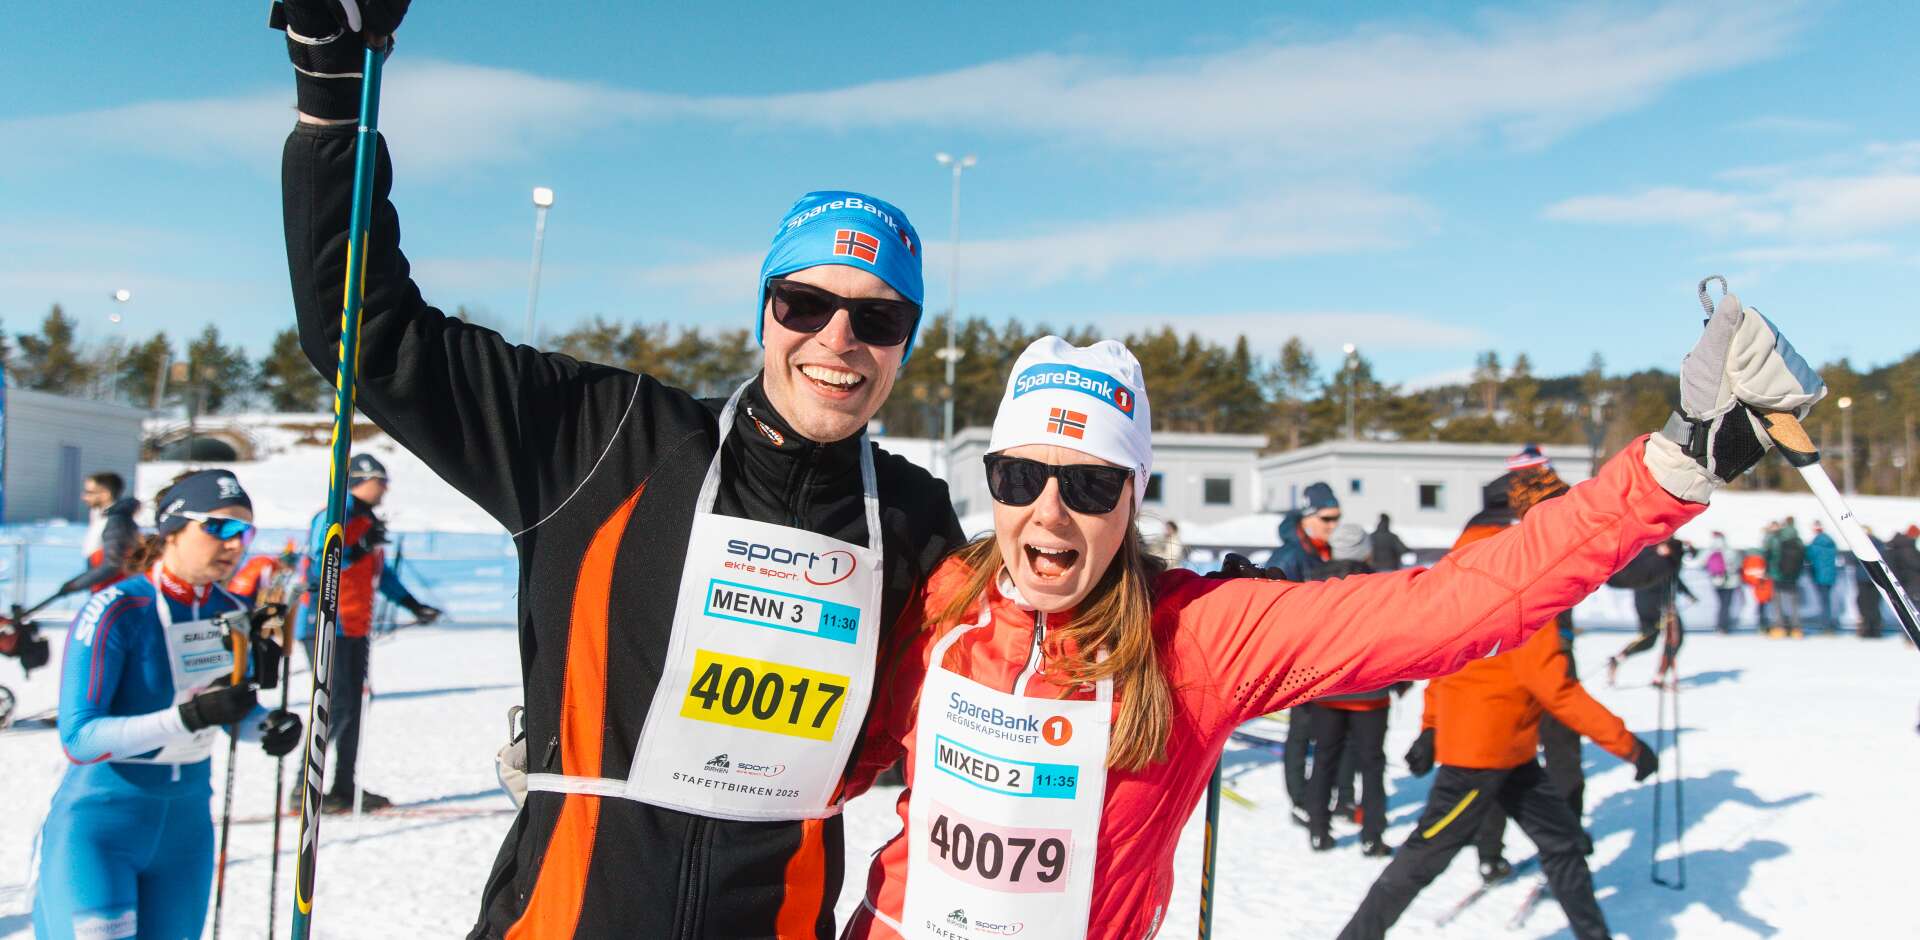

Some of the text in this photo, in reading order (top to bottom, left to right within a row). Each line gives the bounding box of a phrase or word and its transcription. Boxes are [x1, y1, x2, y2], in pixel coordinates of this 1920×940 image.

[787, 198, 899, 232] SpareBank
[1016, 370, 1128, 406] SpareBank 1
[725, 561, 756, 572] ekte
[727, 539, 820, 570] sport
[329, 547, 340, 611] CARBON
[712, 589, 857, 631] MENN 3 11:30
[690, 662, 846, 729] 40017
[949, 692, 1040, 732] SpareBank
[946, 711, 1040, 745] REGNSKAPSHUSET
[738, 762, 770, 773] sport
[939, 744, 1075, 788] MIXED 2 11:35
[672, 772, 800, 798] STAFETTBIRKEN 2025
[930, 814, 1066, 883] 40079
[975, 920, 1008, 931] sport
